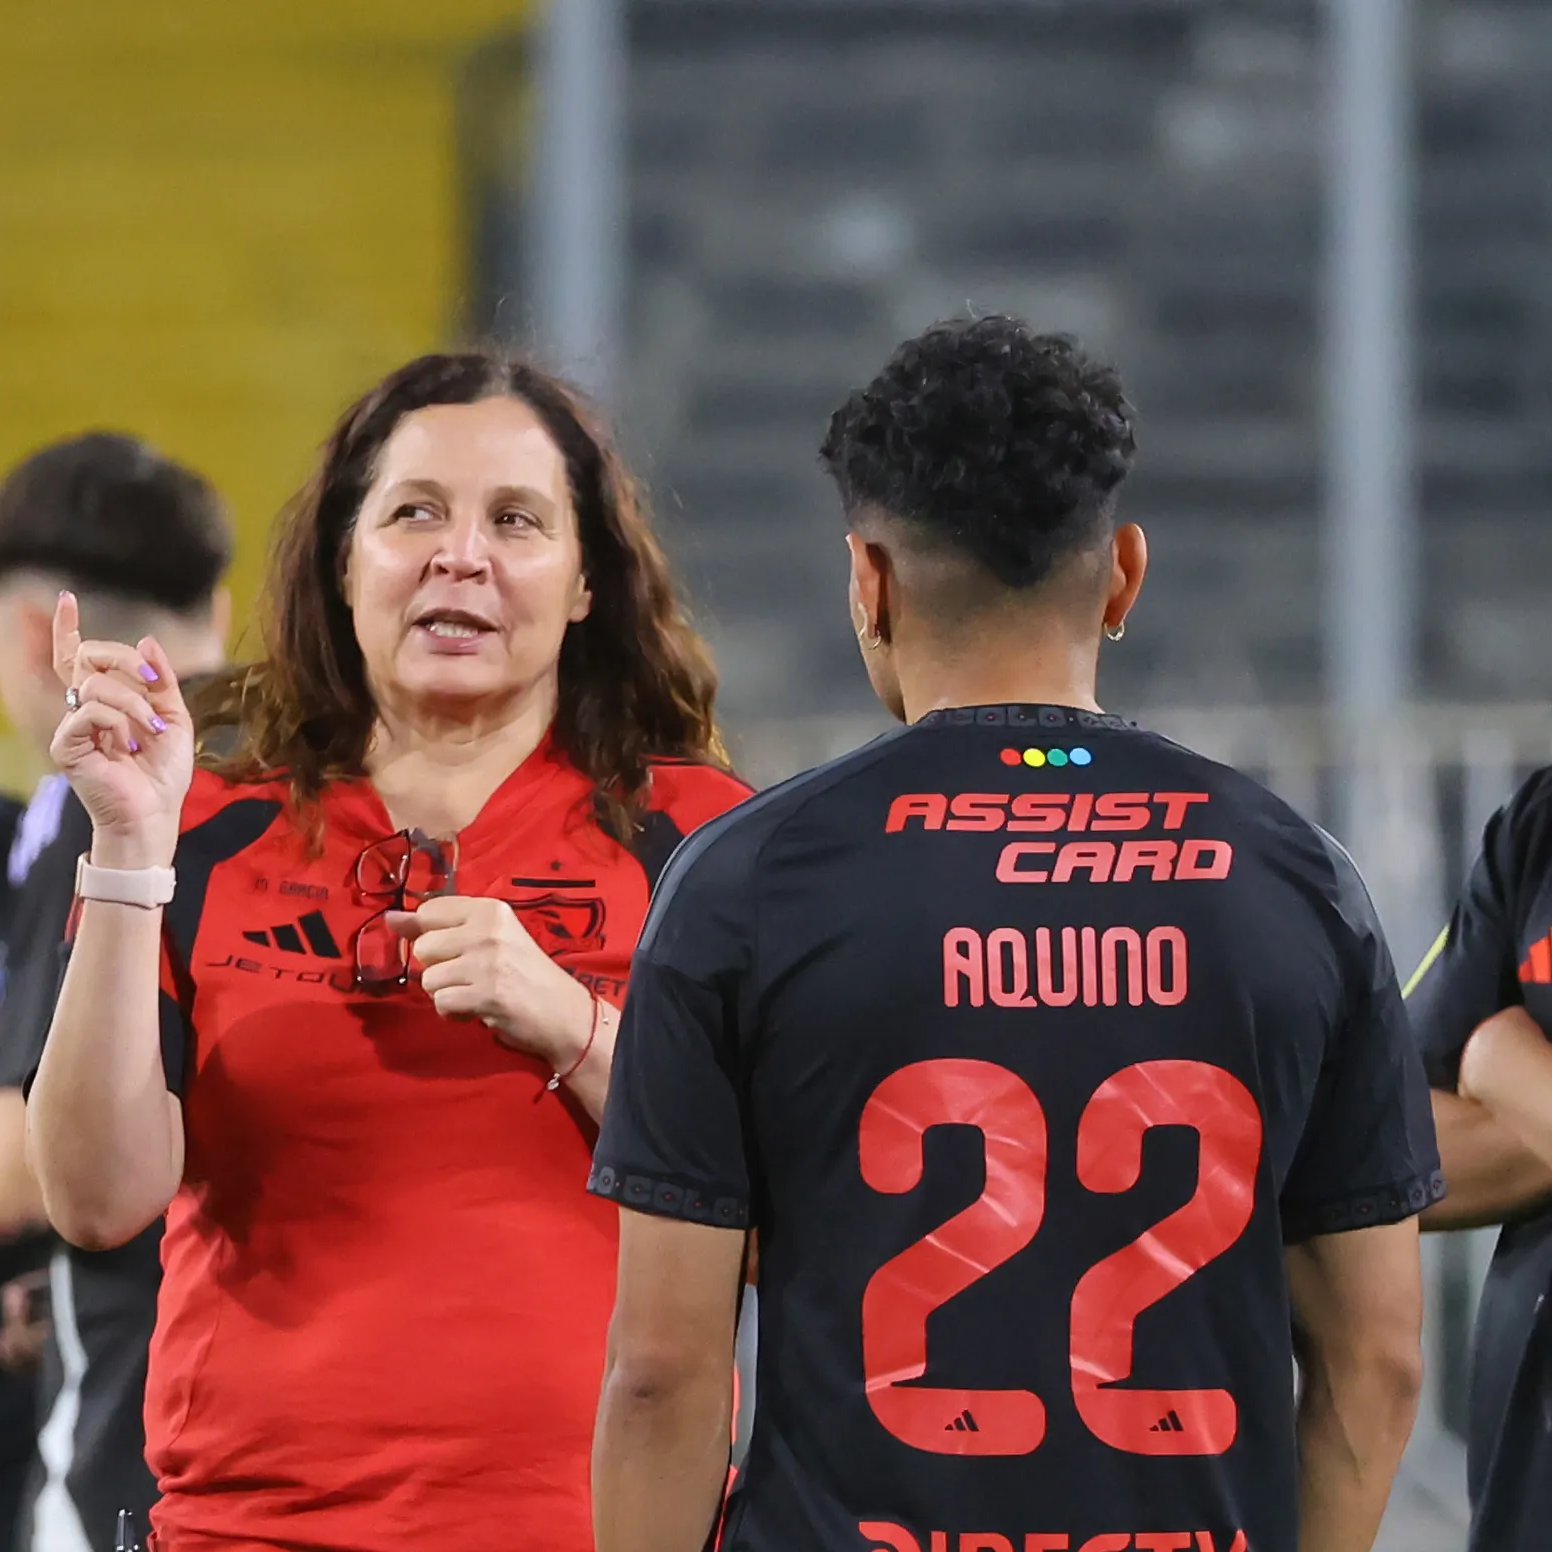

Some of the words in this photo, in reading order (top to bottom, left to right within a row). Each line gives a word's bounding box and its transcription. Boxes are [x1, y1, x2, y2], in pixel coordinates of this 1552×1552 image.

[885, 792, 1210, 833] ASSIST
[995, 839, 1234, 883] CARD
[205, 954, 360, 996] JETOU
[942, 926, 1189, 1007] AQUINO
[858, 1058, 1263, 1456] 22
